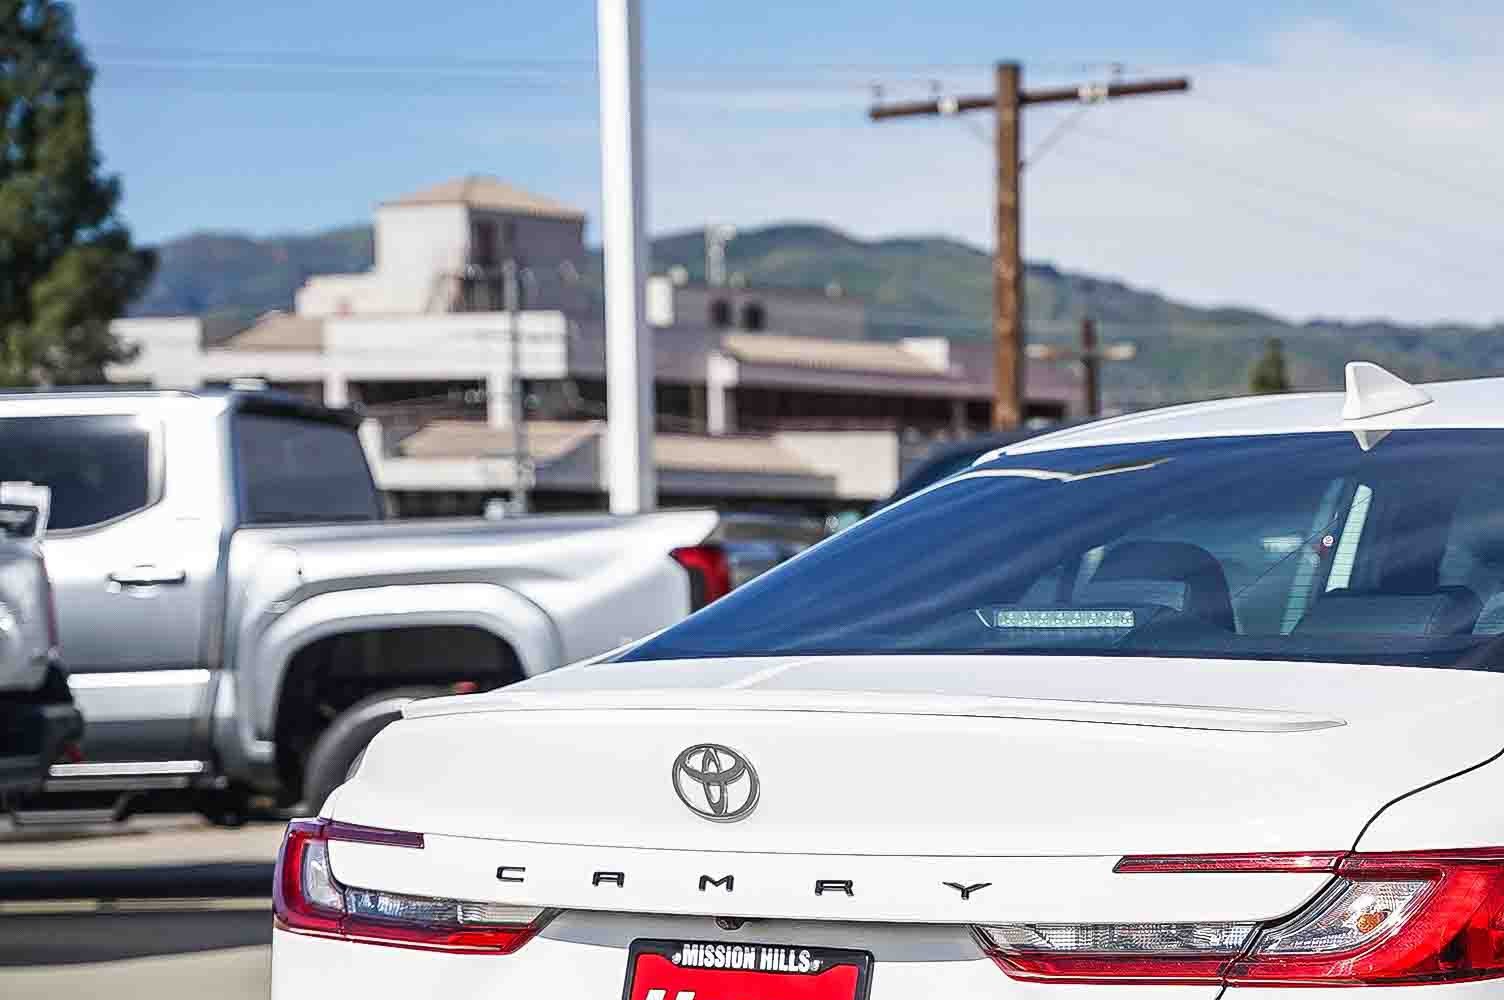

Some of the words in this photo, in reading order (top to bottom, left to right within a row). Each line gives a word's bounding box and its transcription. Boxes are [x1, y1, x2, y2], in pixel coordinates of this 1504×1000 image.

[496, 866, 992, 900] CAMRY
[681, 944, 756, 969] MISSION
[759, 947, 810, 972] HILLS
